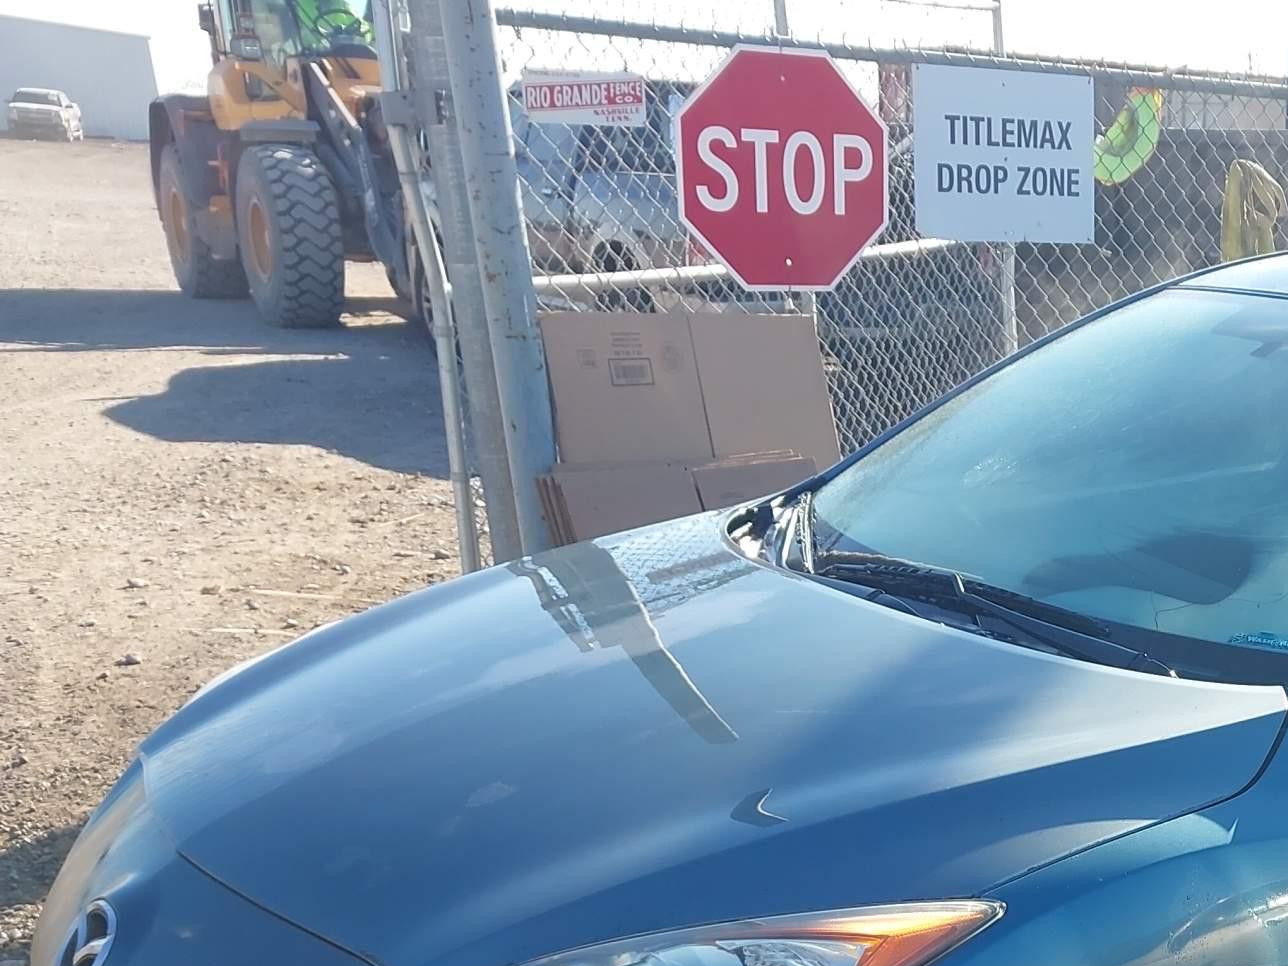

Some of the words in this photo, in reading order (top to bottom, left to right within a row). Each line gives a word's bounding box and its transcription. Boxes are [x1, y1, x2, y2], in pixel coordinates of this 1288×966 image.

[526, 87, 550, 108] RIO
[554, 84, 608, 107] GRANDE
[610, 81, 641, 97] FENCE
[615, 95, 638, 103] CO.
[944, 114, 1072, 150] TITLEMAX
[696, 125, 873, 215] STOP
[937, 163, 1008, 194] DROP
[1016, 166, 1080, 197] ZONE
